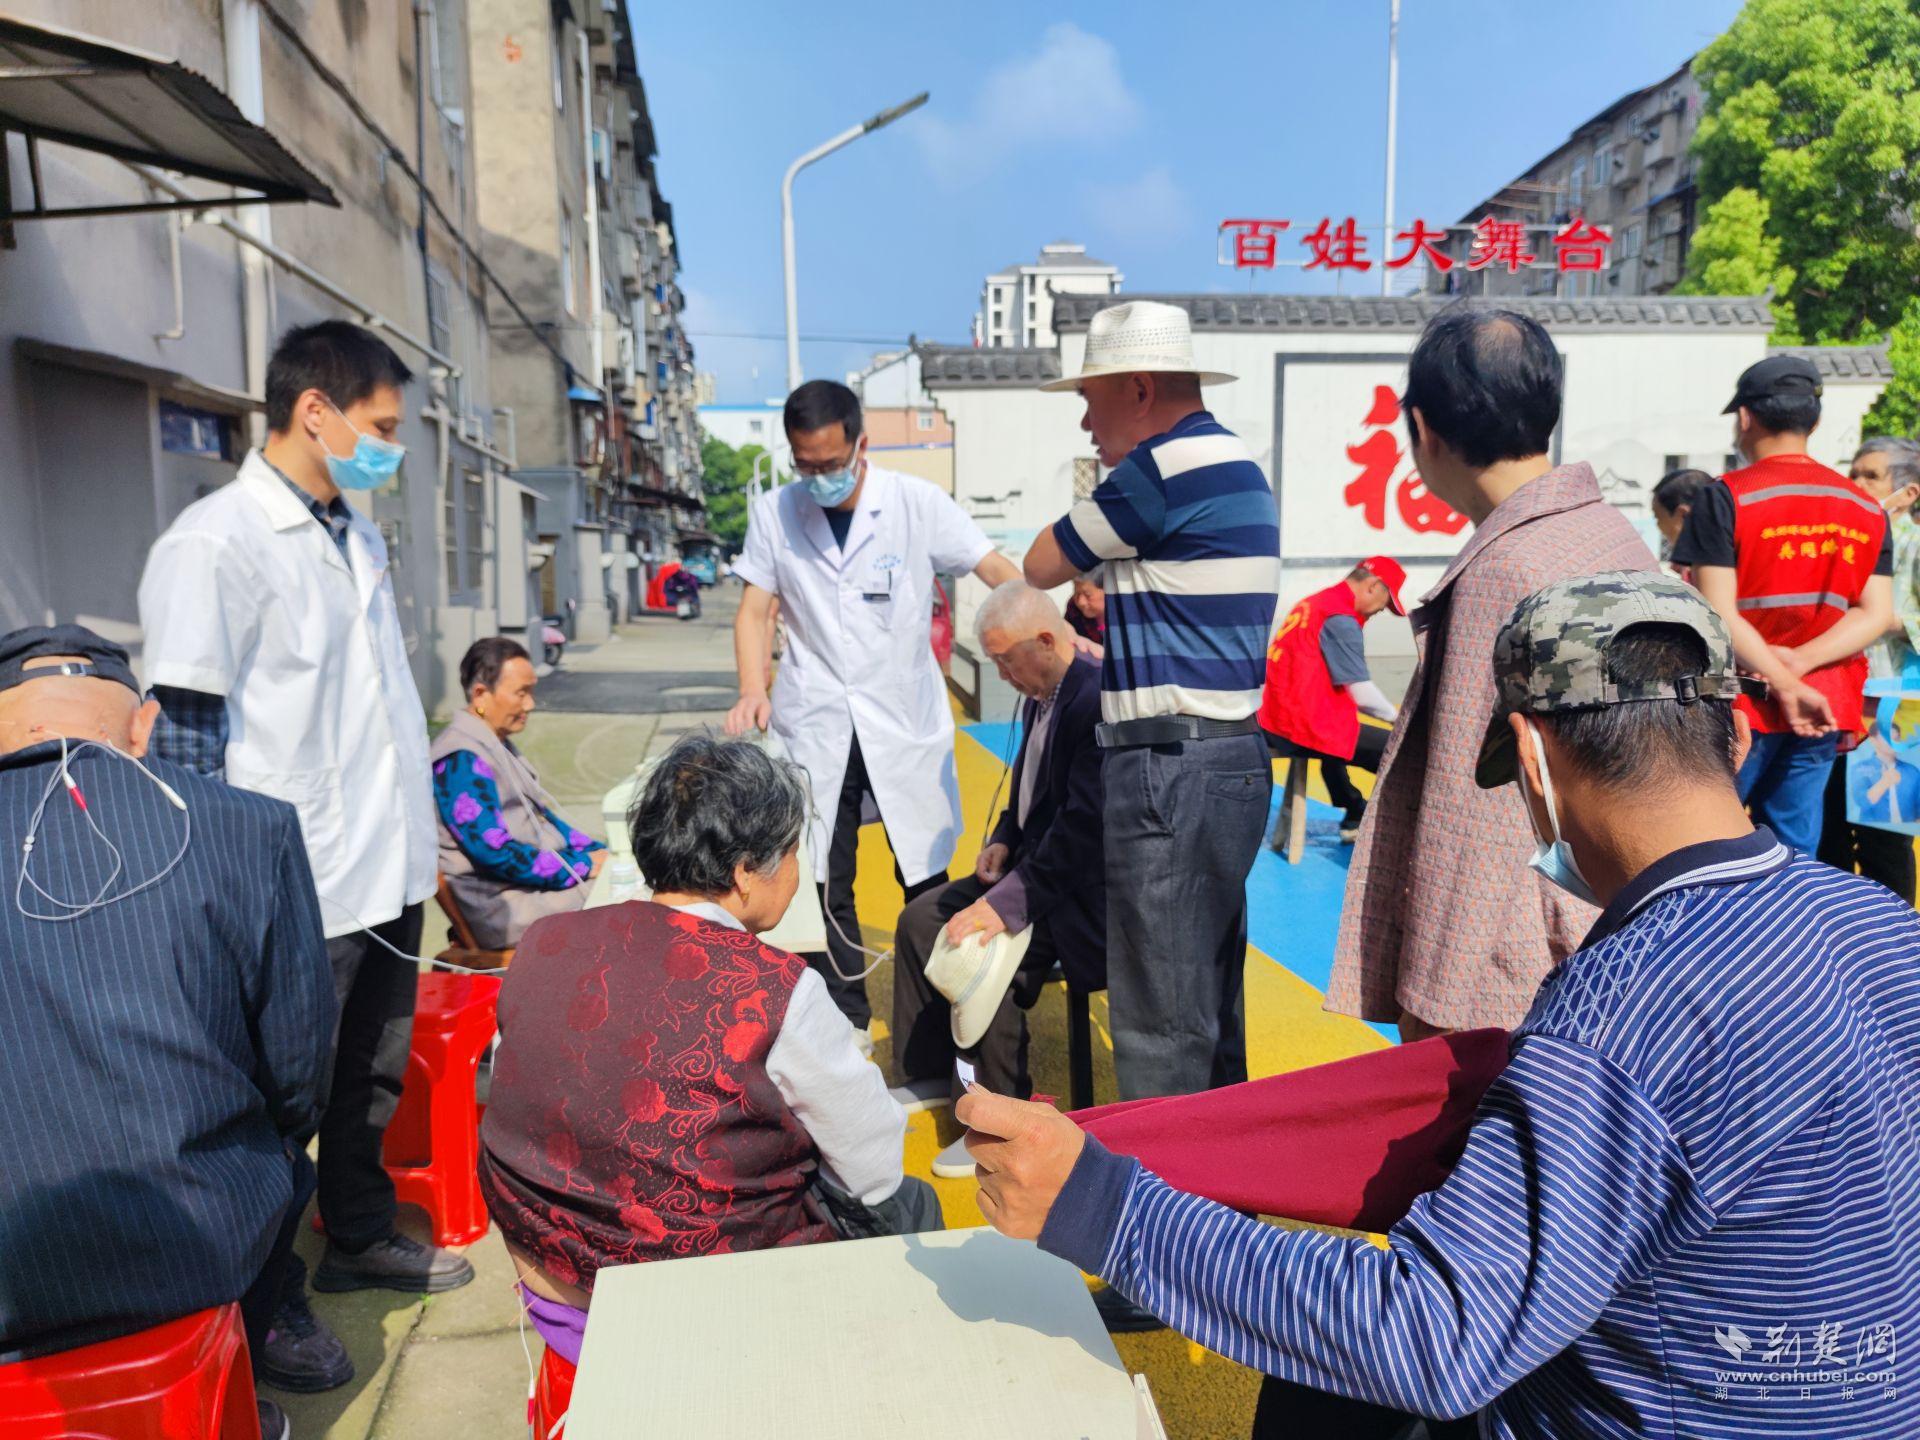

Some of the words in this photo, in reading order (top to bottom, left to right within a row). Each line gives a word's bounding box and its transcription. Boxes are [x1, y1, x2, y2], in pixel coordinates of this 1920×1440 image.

[1220, 216, 1613, 273] 百姓大舞台
